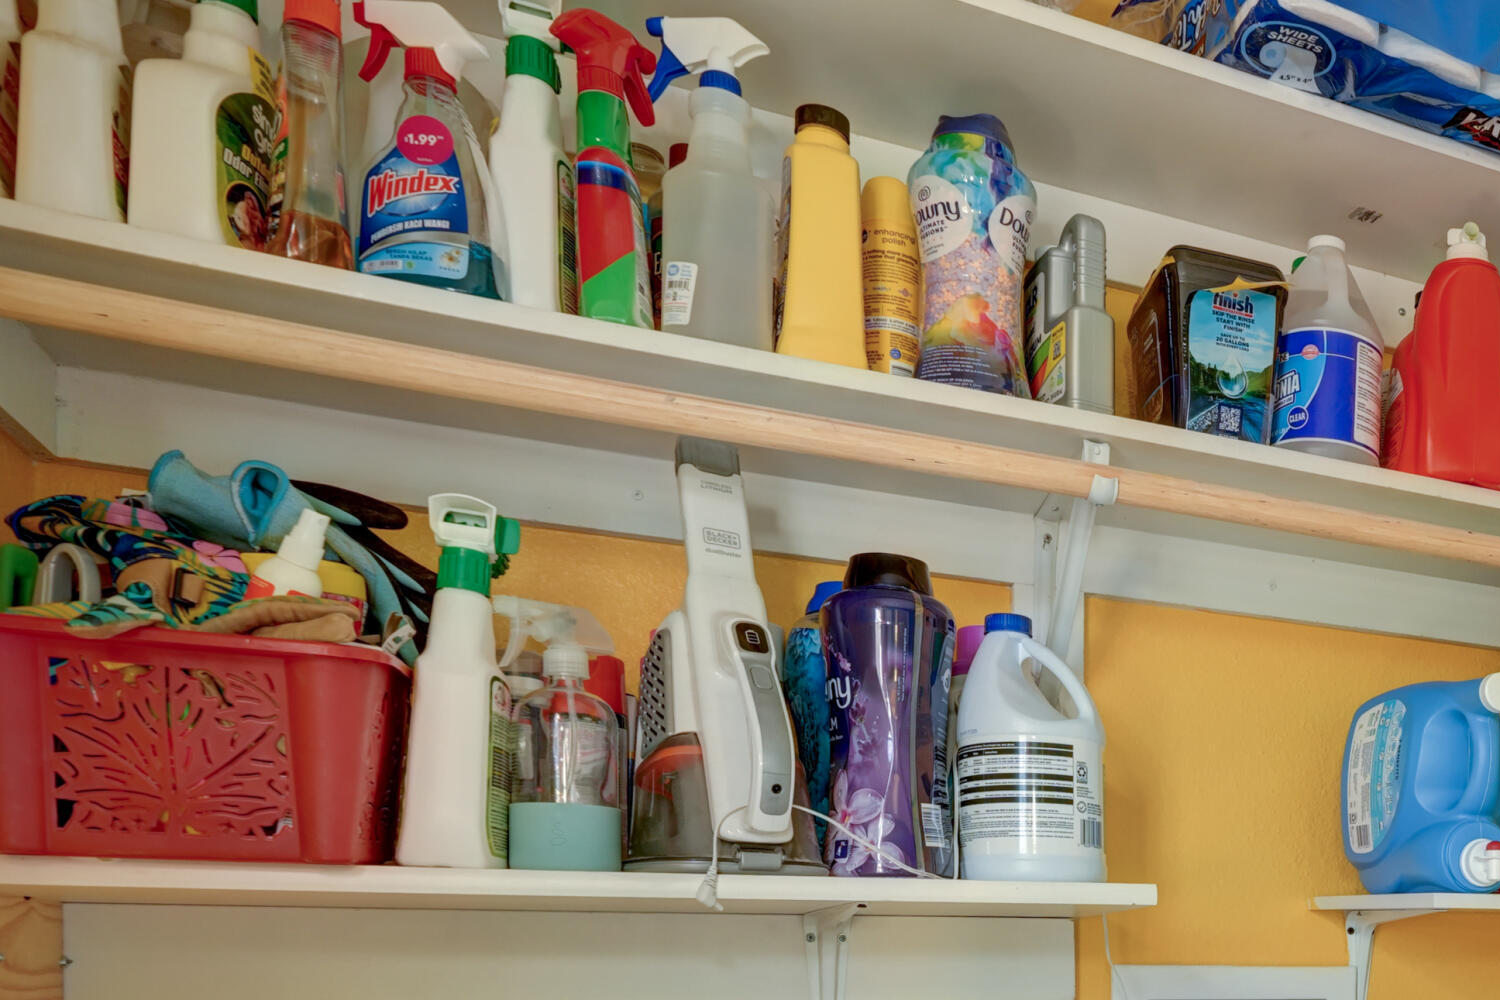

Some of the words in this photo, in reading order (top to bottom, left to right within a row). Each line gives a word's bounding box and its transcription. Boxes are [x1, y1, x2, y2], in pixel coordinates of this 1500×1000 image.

[1268, 32, 1323, 53] SHEETS
[1280, 26, 1319, 43] WIDE
[224, 148, 252, 178] Odor
[368, 168, 459, 217] Windex
[920, 220, 945, 233] LTIMATE
[1000, 206, 1030, 243] Dow
[882, 238, 906, 246] polish
[1213, 291, 1254, 314] finish
[1216, 317, 1234, 326] START
[1236, 320, 1251, 329] WITH
[1224, 338, 1250, 348] GALLONS
[1290, 412, 1306, 423] CLEAR
